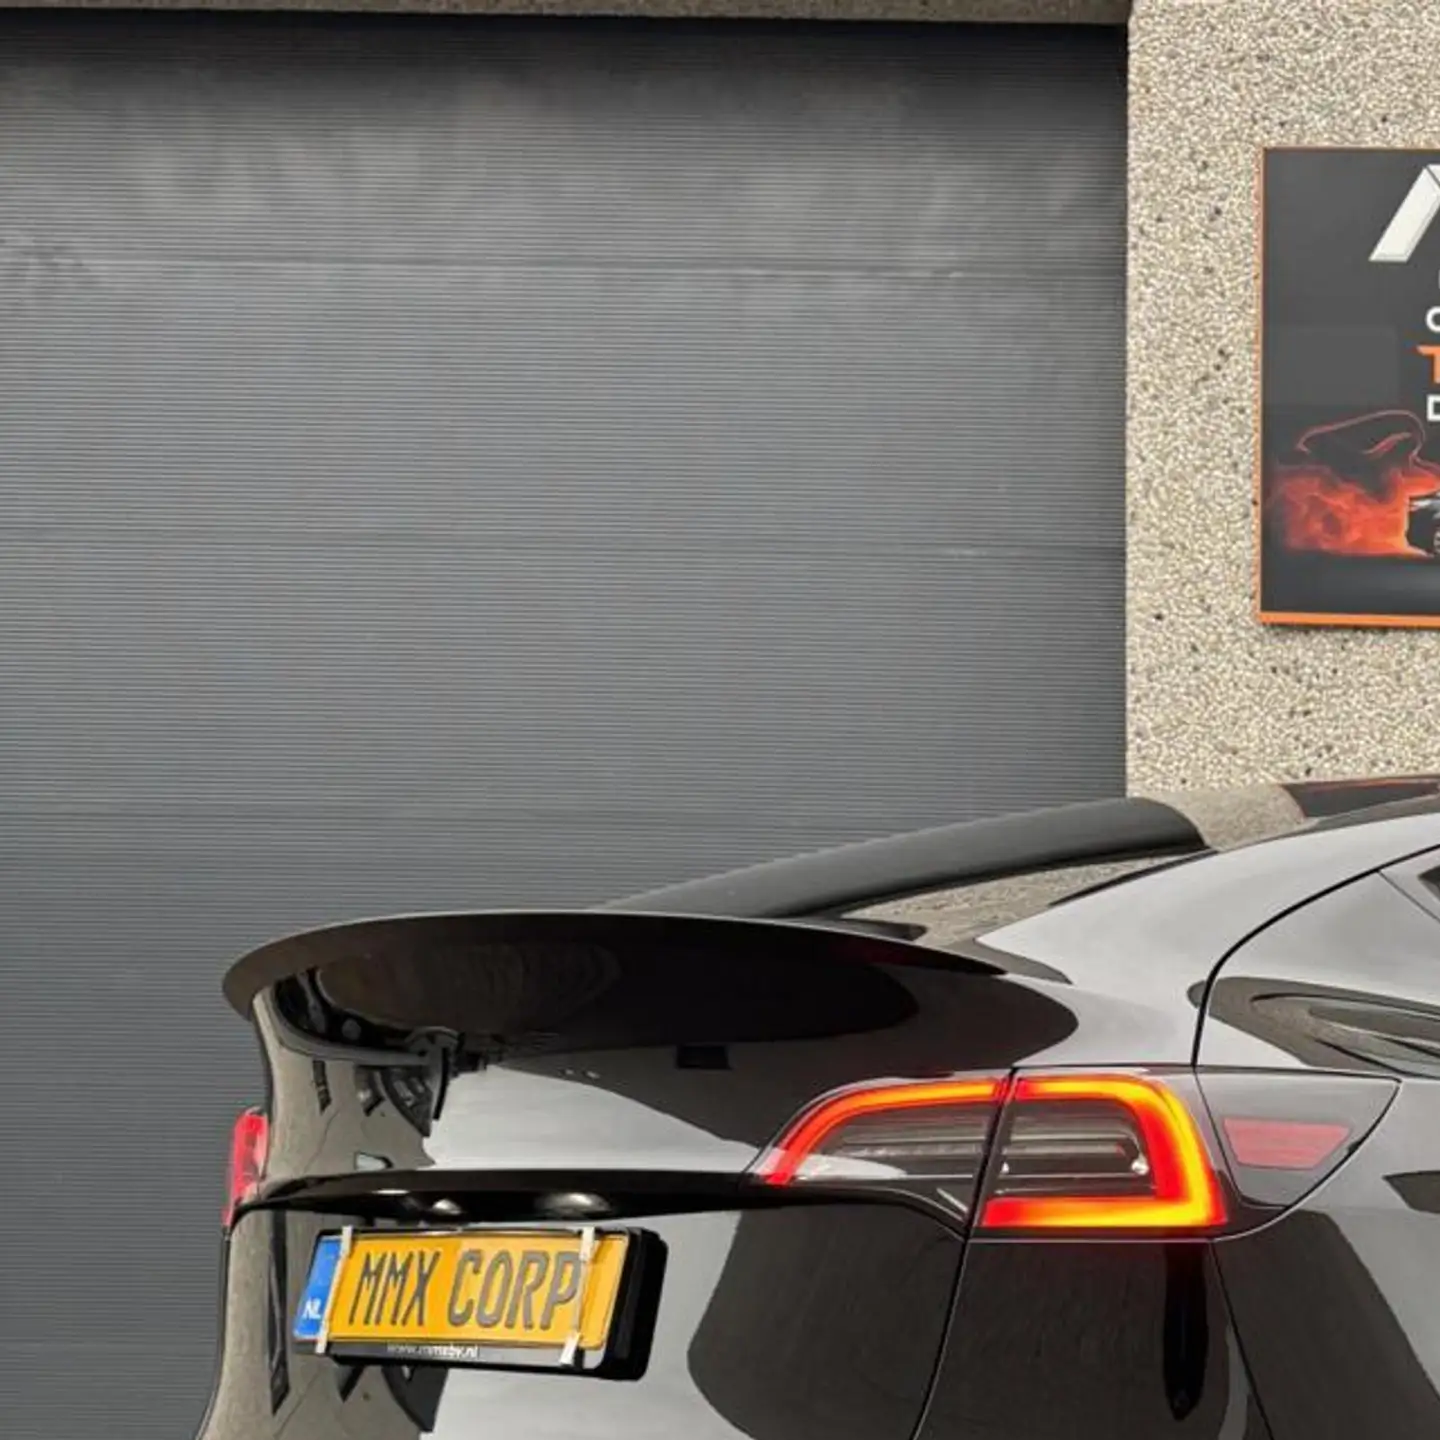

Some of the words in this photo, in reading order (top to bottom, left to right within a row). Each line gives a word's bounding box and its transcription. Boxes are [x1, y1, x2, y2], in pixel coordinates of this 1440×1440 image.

[302, 1300, 322, 1319] NL
[349, 1250, 440, 1326] MMX
[447, 1249, 582, 1330] CORP
